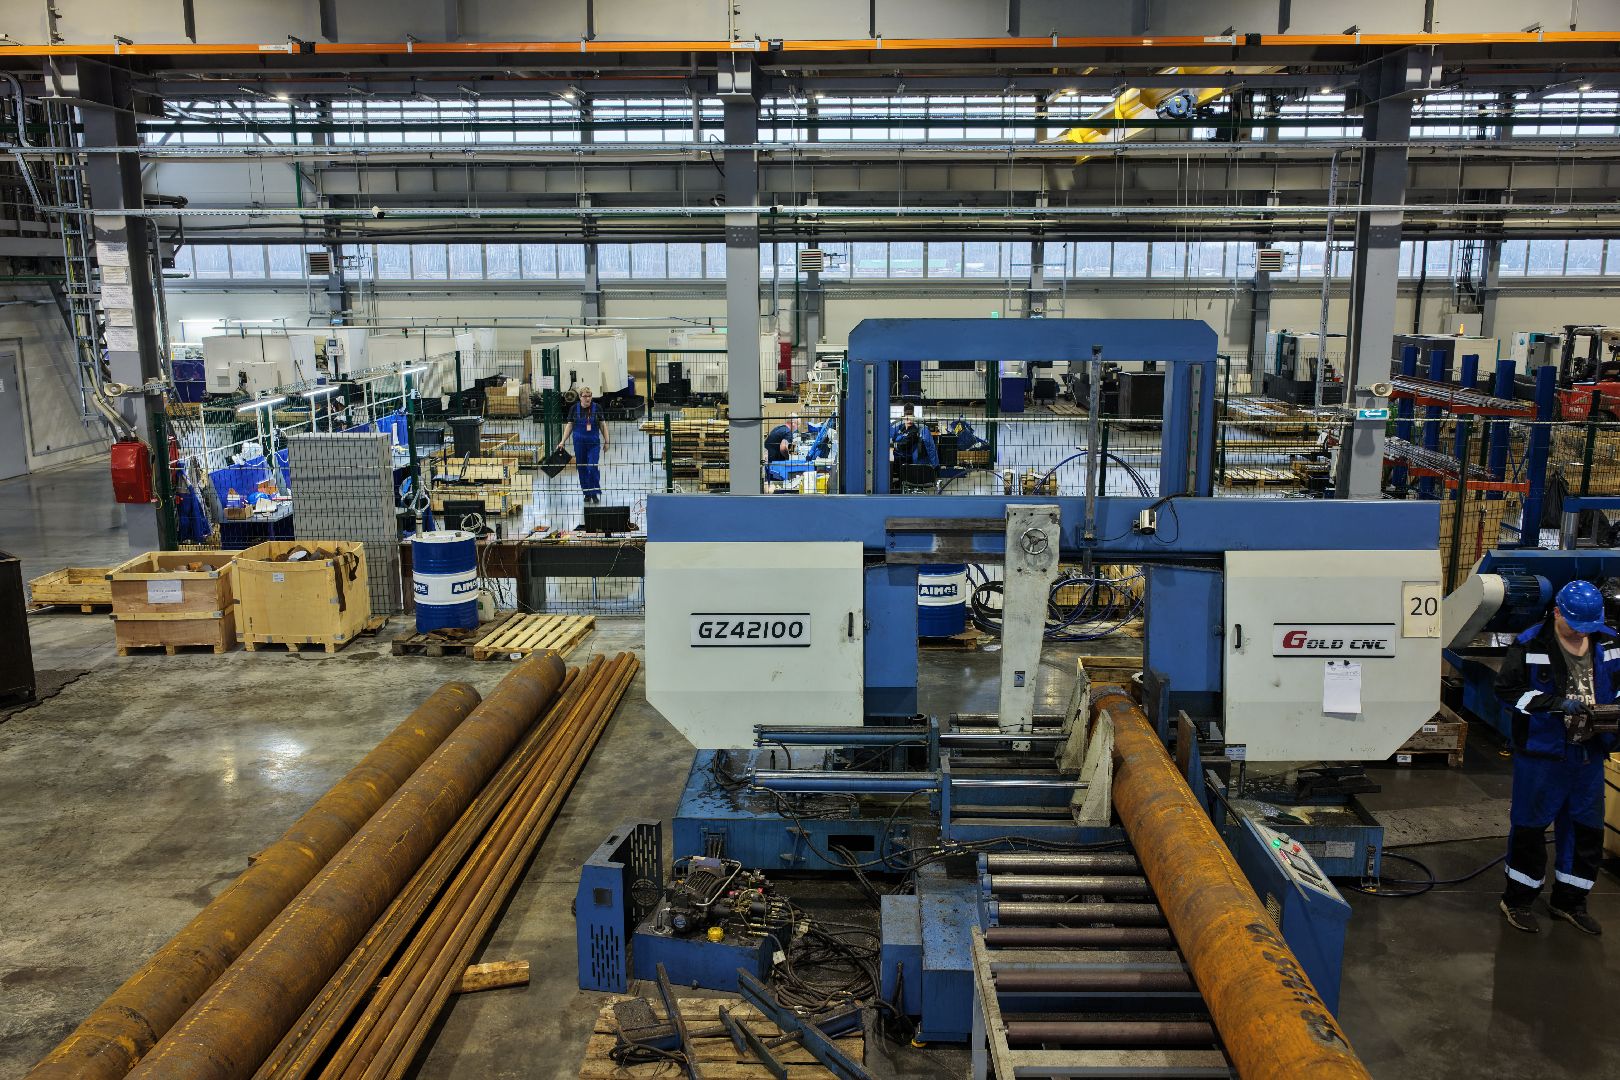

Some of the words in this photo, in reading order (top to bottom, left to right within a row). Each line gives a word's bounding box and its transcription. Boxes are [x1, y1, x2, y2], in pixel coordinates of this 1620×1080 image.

[1411, 597, 1438, 616] 20
[698, 621, 803, 639] GZ42100
[1349, 639, 1388, 650] CNC
